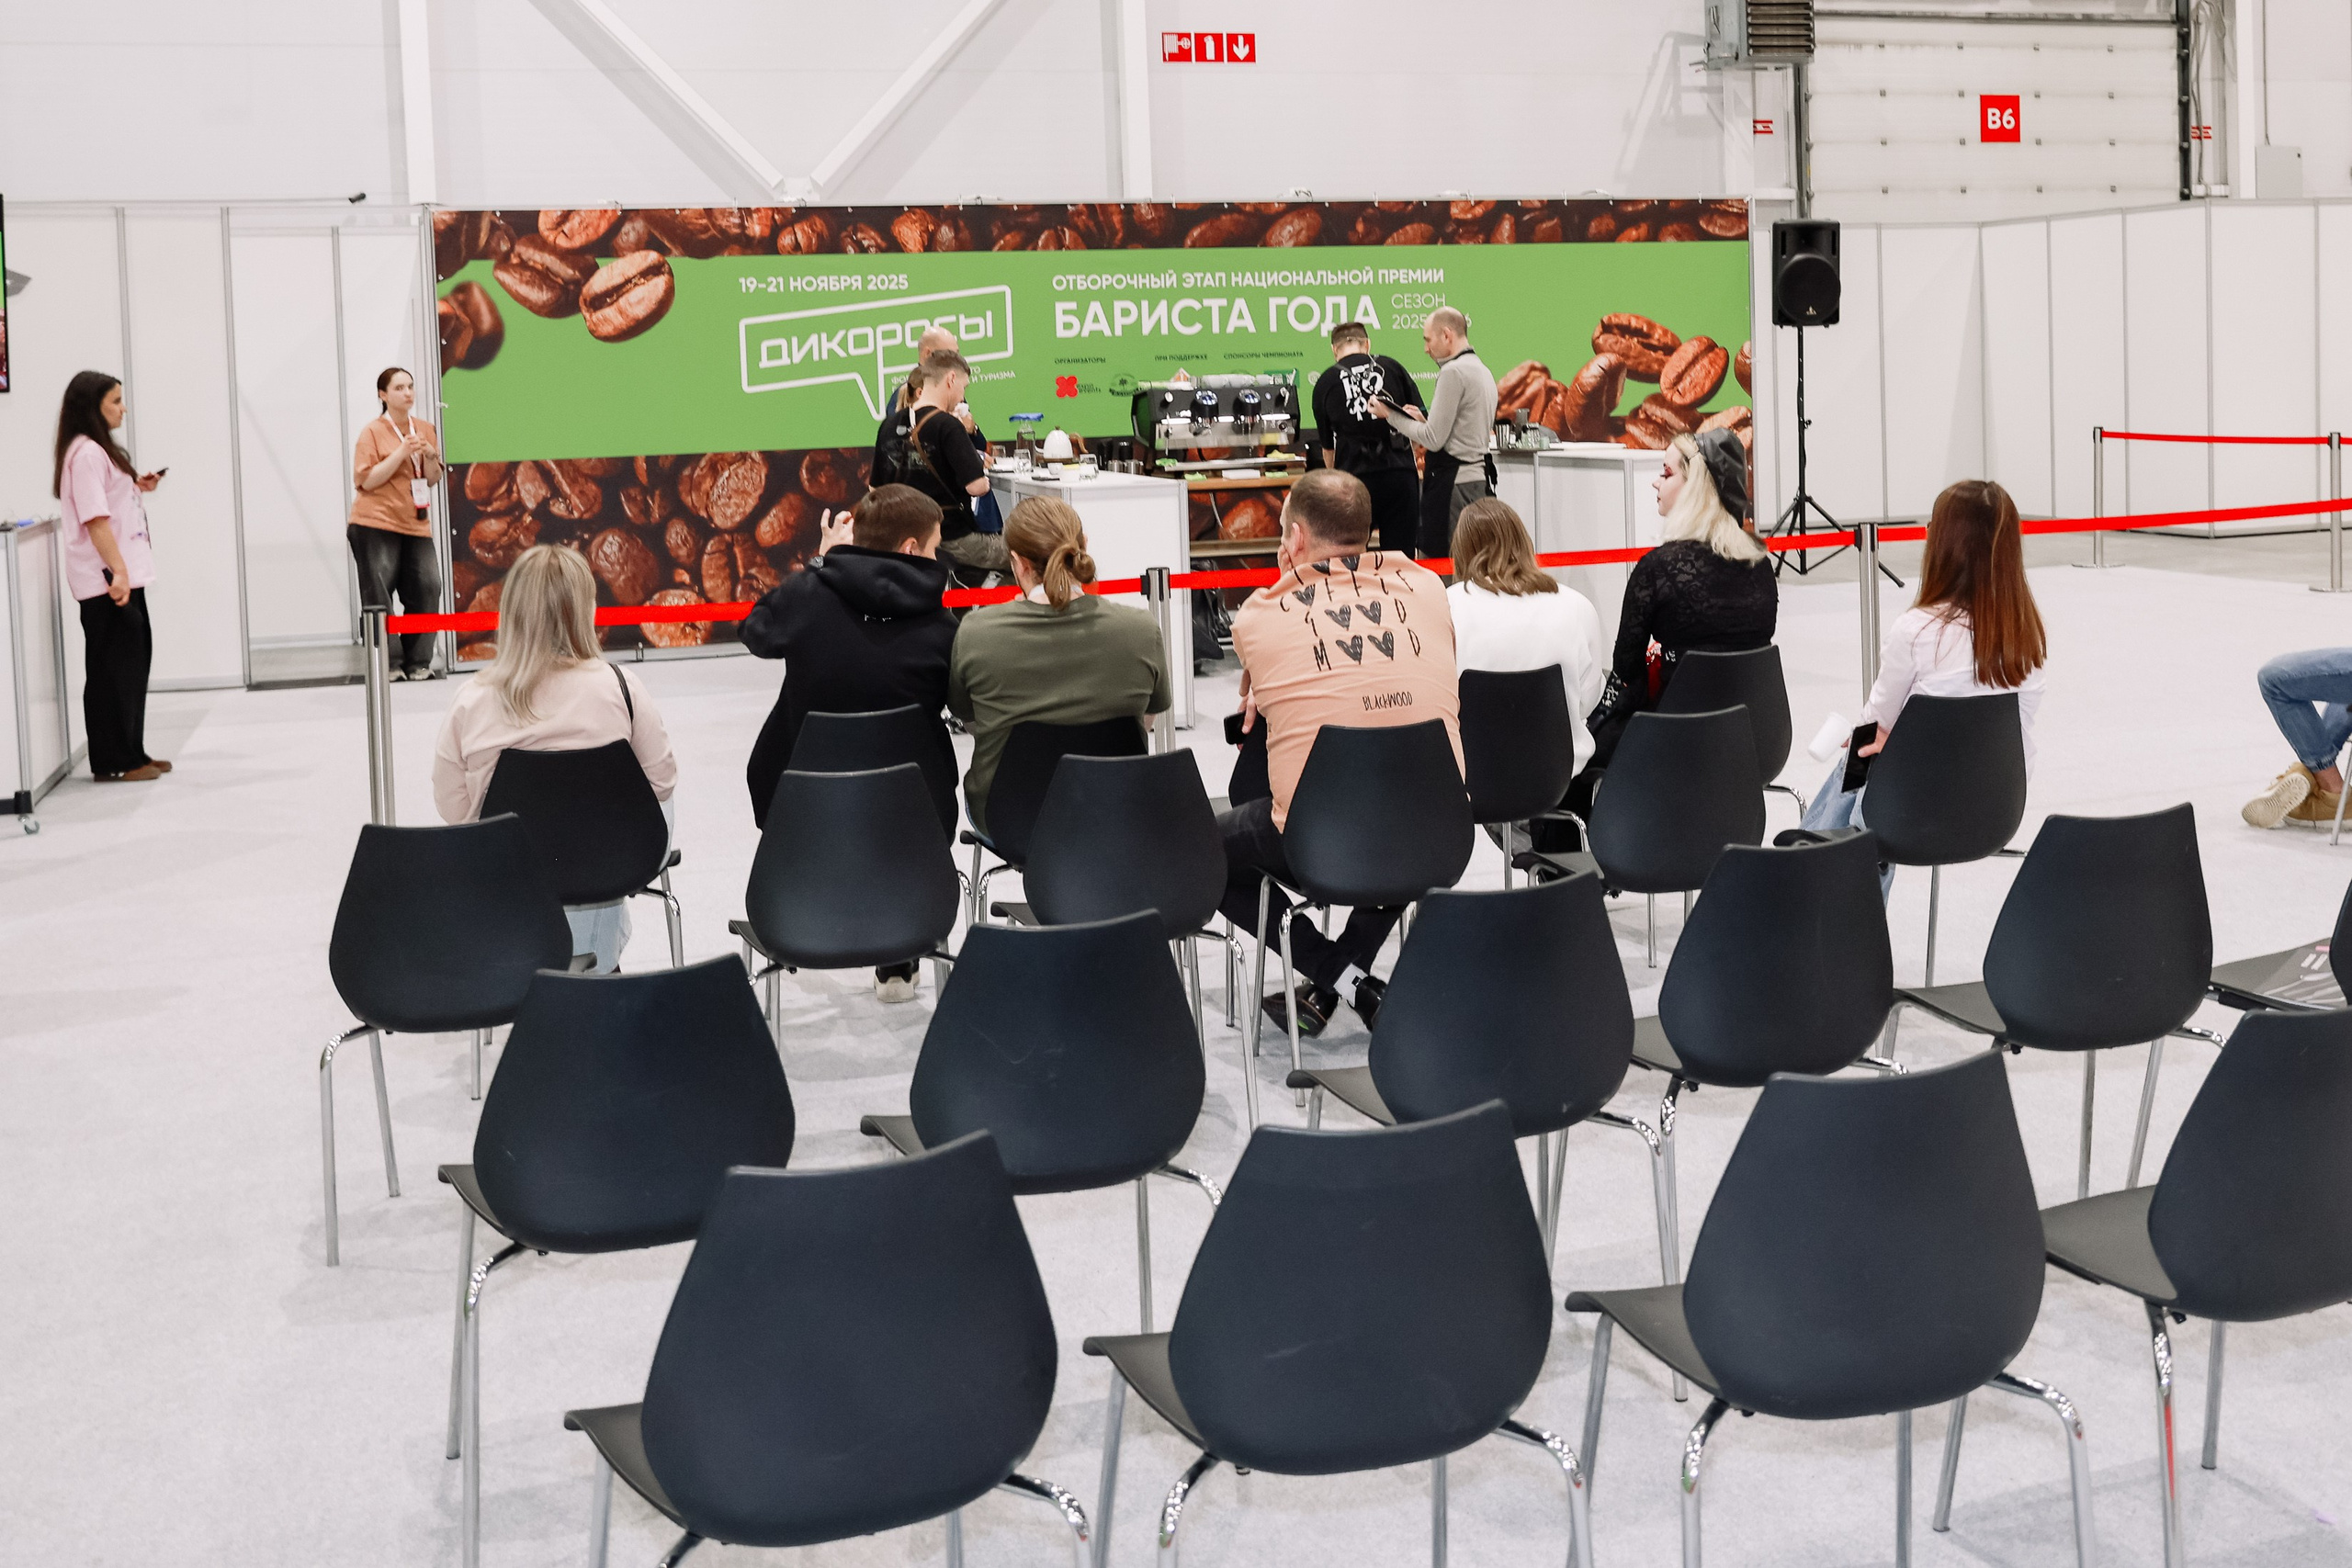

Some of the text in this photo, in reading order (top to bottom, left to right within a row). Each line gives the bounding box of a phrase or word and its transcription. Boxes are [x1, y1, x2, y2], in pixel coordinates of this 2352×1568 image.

[739, 274, 909, 293] 19-21 НОЯБРЯ 2025
[1052, 265, 1444, 291] ОТБОРОЧНЫЙ ЭТАП НАЦИОНАЛЬНОЙ ПРЕМИИ
[1391, 292, 1446, 309] СЕЗОН
[1055, 294, 1382, 338] БАРИСТА ГОДА
[979, 370, 1016, 383] ТУРИЗМА
[1363, 691, 1413, 711] BLACKWOOD
